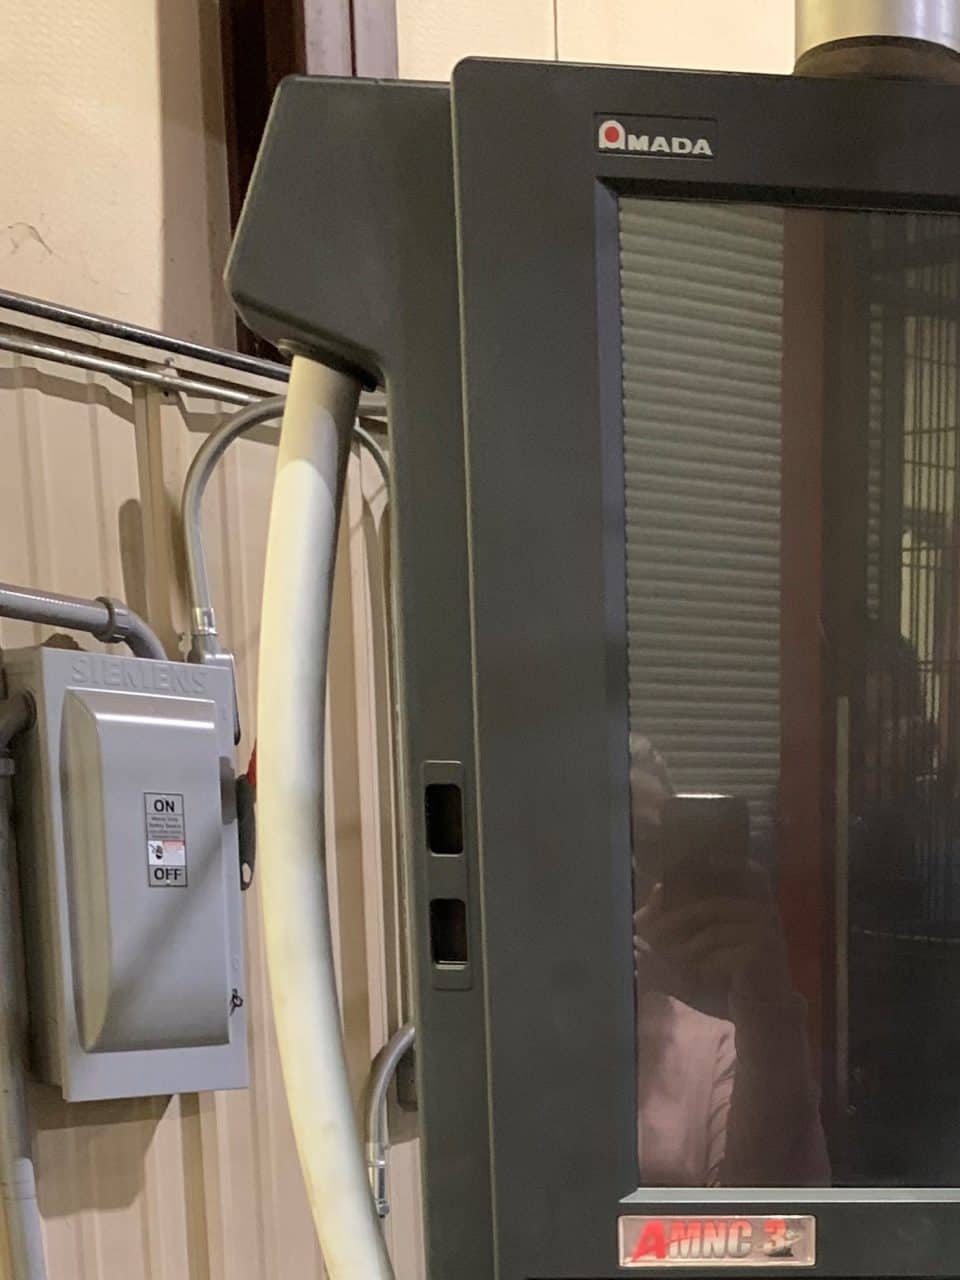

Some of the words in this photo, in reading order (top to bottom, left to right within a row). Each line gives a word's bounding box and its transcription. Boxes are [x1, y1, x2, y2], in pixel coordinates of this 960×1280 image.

[598, 119, 714, 156] AMADA
[71, 657, 209, 694] SIEMENS
[153, 799, 175, 813] ON
[153, 867, 182, 881] OFF
[631, 1219, 752, 1262] AMNC
[763, 1217, 790, 1257] 3
